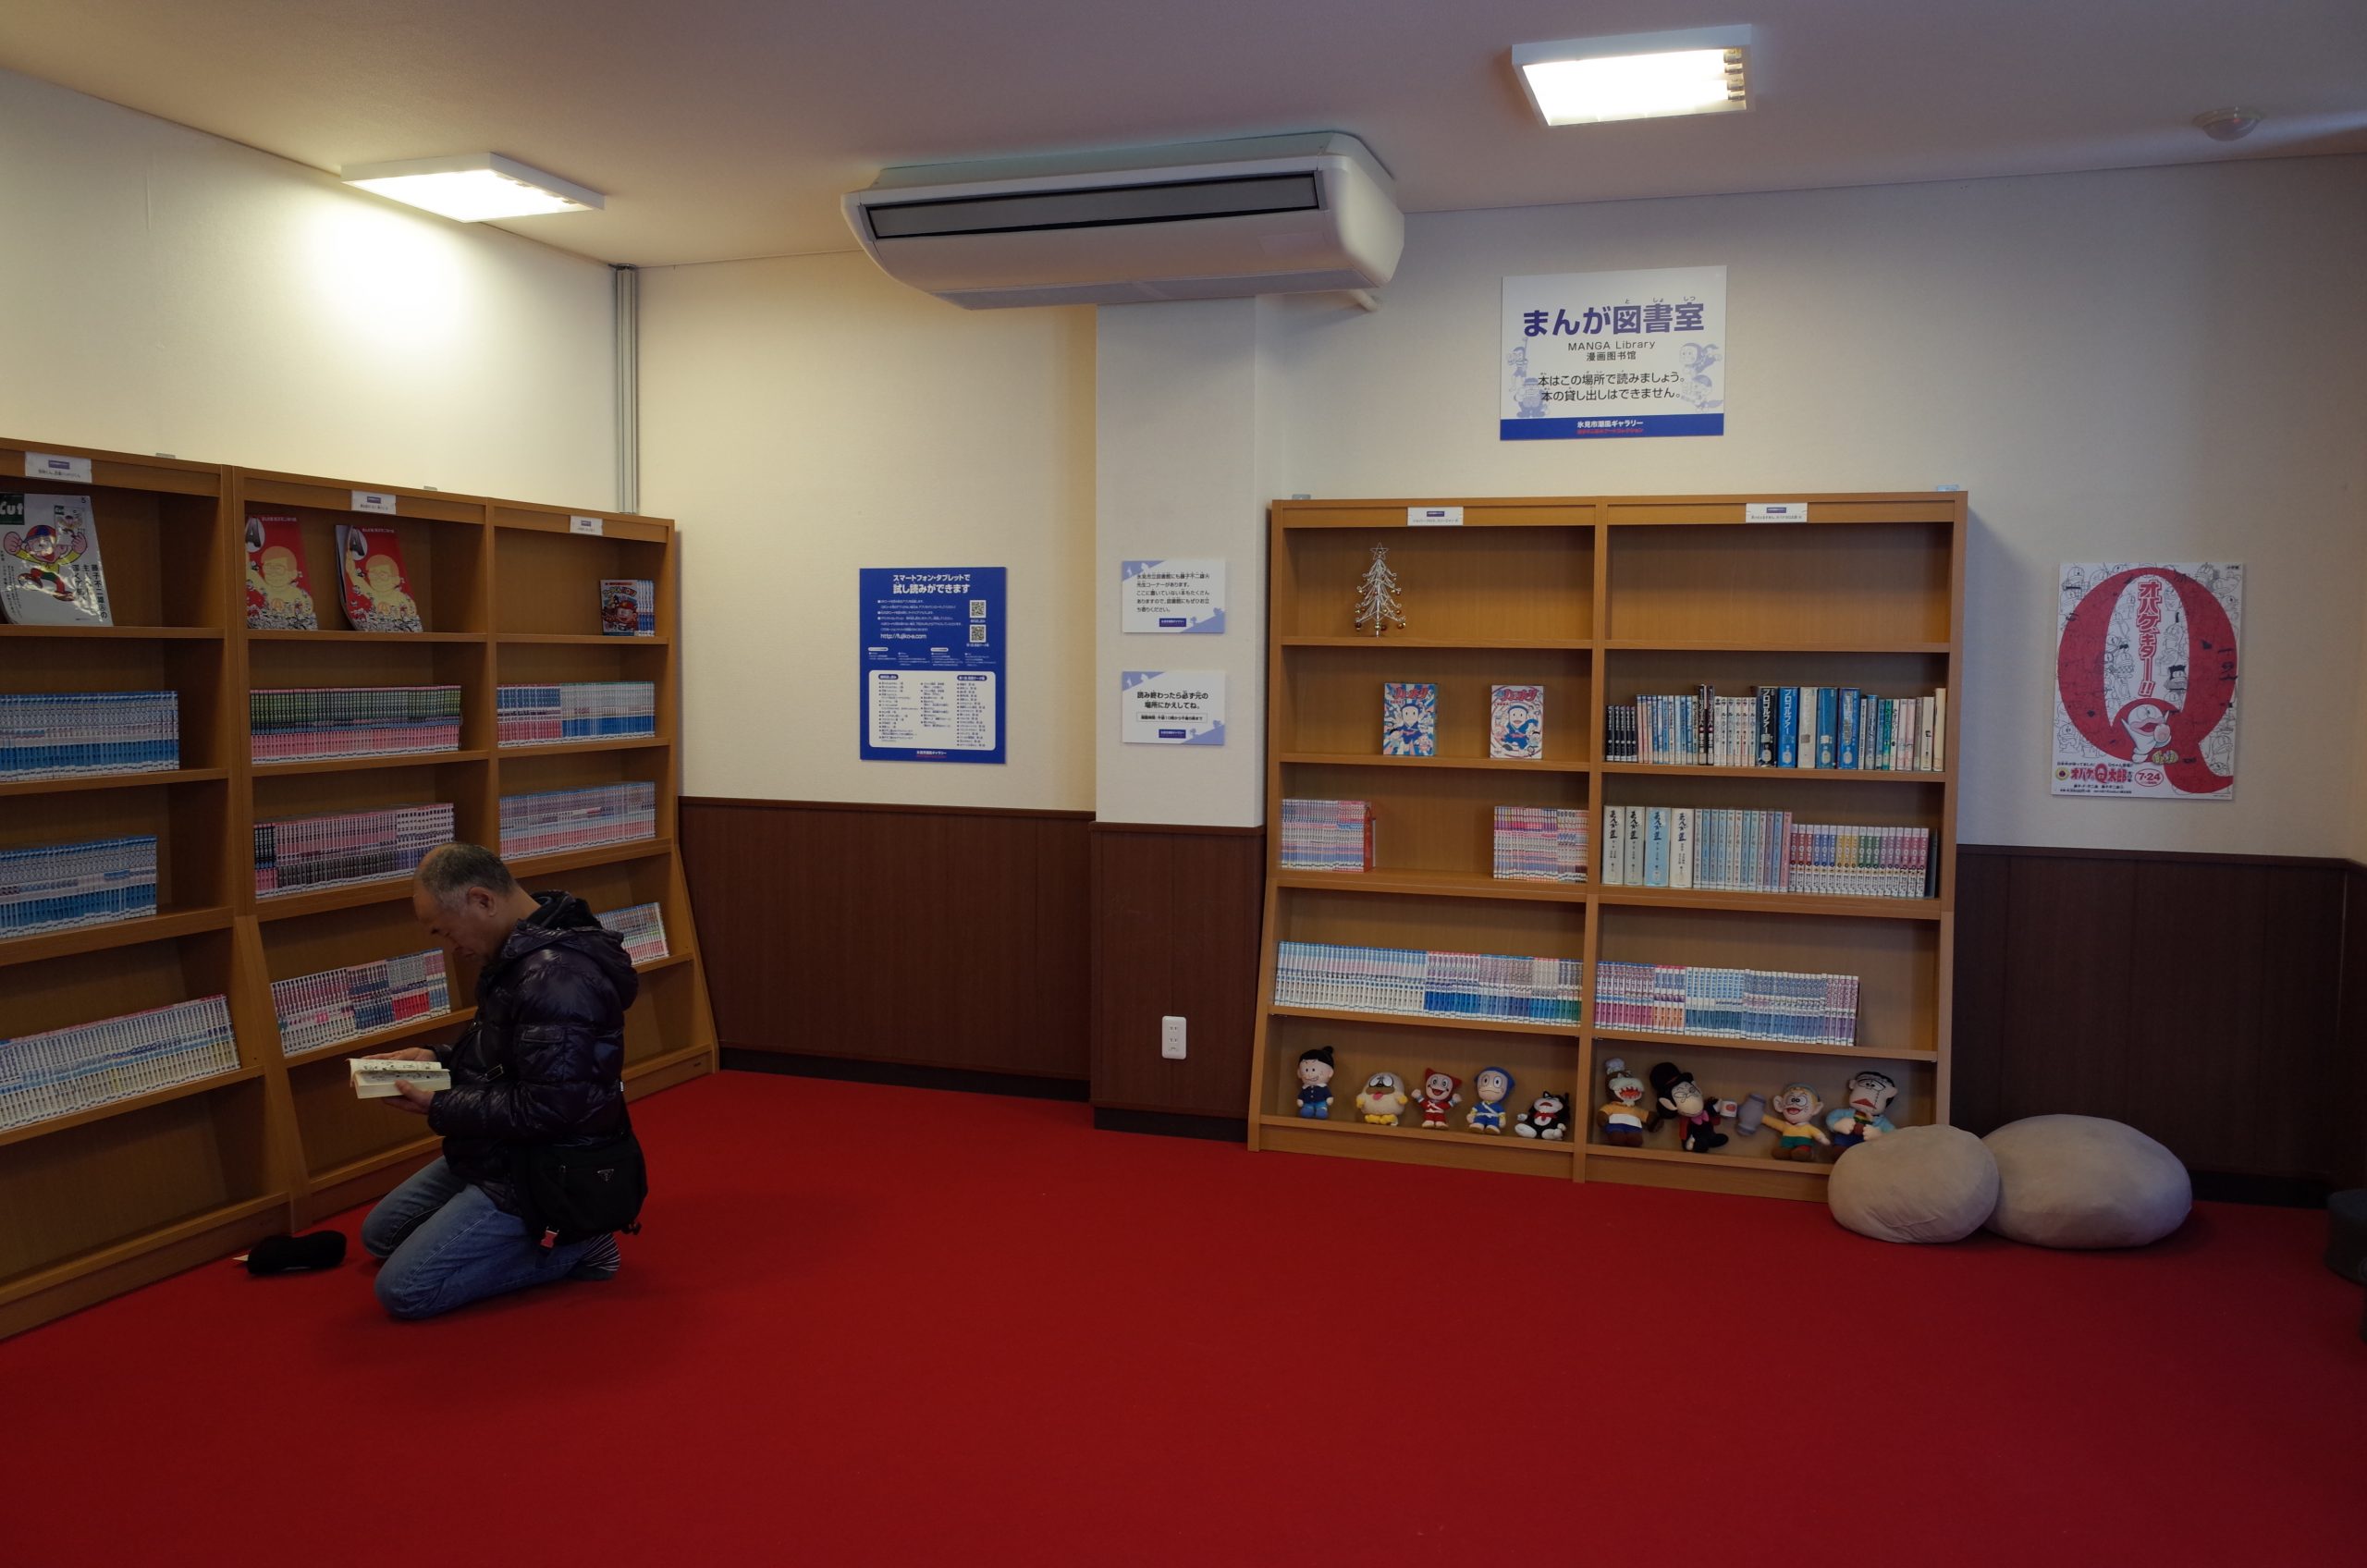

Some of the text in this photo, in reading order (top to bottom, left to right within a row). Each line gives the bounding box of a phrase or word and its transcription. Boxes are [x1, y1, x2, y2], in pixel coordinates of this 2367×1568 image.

[1523, 302, 1704, 337] まんが図書室
[1568, 340, 1655, 351] MANGA Library
[1587, 350, 1637, 361] 漫画图书馆
[1538, 372, 1685, 386] 本はこの場所で読みましょう。
[1540, 387, 1681, 402] 本の貸し出しはできません。
[893, 583, 971, 594] 試し読みができます
[1137, 692, 1208, 700] 読み終わったら必ず元の
[1145, 701, 1200, 710] 場所にかえしてね。
